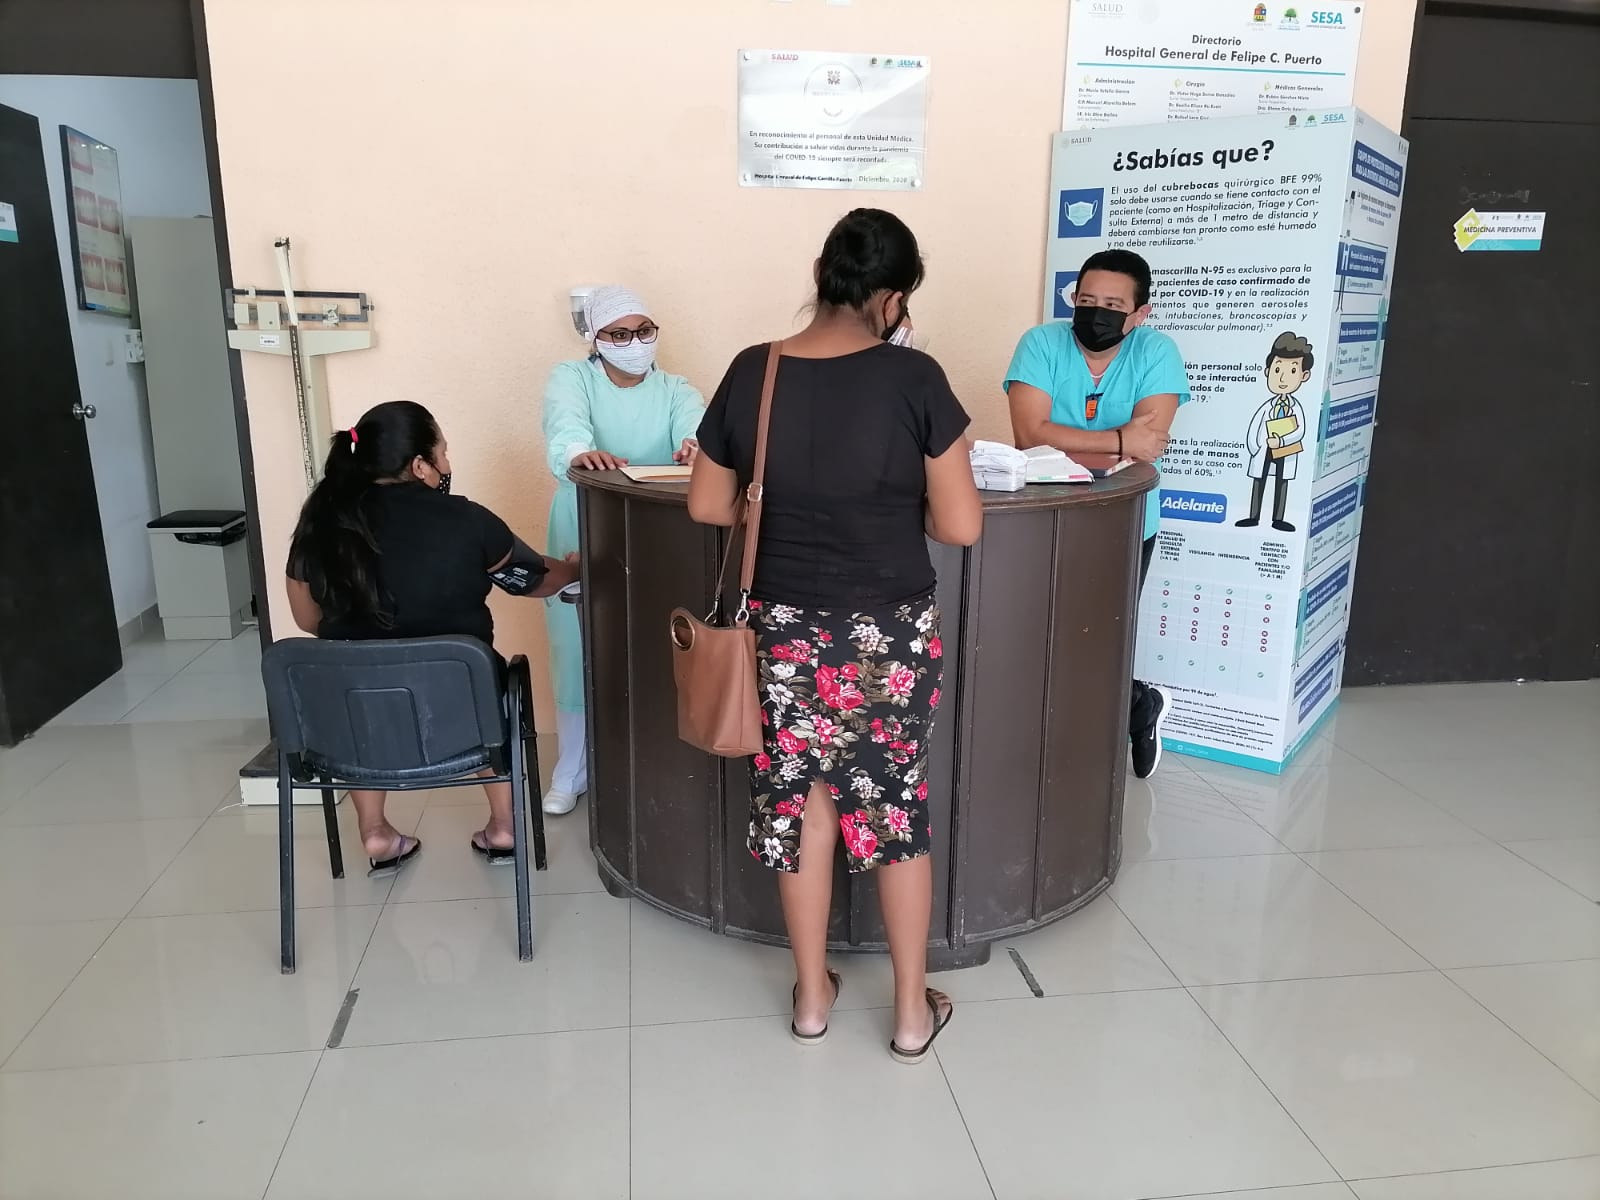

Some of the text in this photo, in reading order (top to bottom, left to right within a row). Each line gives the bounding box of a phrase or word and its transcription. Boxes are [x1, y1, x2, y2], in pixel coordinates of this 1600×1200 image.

[1092, 3, 1123, 12] SALUD
[1311, 11, 1343, 25] SESA
[1191, 34, 1242, 46] Directorio
[1105, 45, 1322, 65] Hospital General de Felipe C. Puerto
[1324, 113, 1345, 122] SESA
[817, 154, 842, 163] siempre
[1112, 139, 1275, 172] ¿Sabías que?
[1111, 173, 1322, 195] El uso del cubrebocas quirúrgico BFE 99%
[1110, 185, 1321, 205] solo debe usarse cuando se tiene contacto con el
[1109, 207, 1144, 218] paciente
[1145, 205, 1171, 216] (como
[1186, 201, 1254, 213] Hospitalización,
[1257, 200, 1286, 210] Triage
[1287, 200, 1294, 209] y
[1295, 197, 1319, 207] Con-
[1108, 217, 1128, 227] sulta
[1131, 216, 1164, 226] Externa)
[1176, 215, 1194, 223] más
[1197, 214, 1209, 223] de
[1213, 213, 1218, 222] 1
[1222, 213, 1248, 222] metro
[1252, 211, 1264, 220] de
[1267, 209, 1309, 219] distancia
[1312, 211, 1319, 219] y
[1138, 226, 1180, 236] cambiarse
[1183, 226, 1197, 234] tan
[1198, 225, 1228, 236] pronto
[1257, 222, 1275, 231] esté
[1107, 241, 1112, 249] y
[1126, 238, 1147, 247] debe
[1151, 266, 1199, 275] mascarilla
[1201, 265, 1225, 275] N-95
[1238, 264, 1278, 274] exclusivo
[1279, 266, 1301, 275] para
[1303, 263, 1312, 273] la
[1157, 275, 1311, 288] pacientes de caso confirmado de
[1160, 291, 1176, 299] por
[1178, 288, 1225, 297] COVID-19
[1227, 290, 1232, 298] y
[1249, 287, 1258, 296] la
[1260, 287, 1310, 297] realización
[1192, 302, 1210, 310] que
[1215, 302, 1255, 310] generen
[1261, 299, 1309, 308] aerosoles
[1165, 311, 1307, 322] intubaciones, y
[1154, 321, 1215, 331] cardiovascular
[1217, 322, 1266, 333] pulmonar).
[1201, 362, 1242, 371] personal
[1244, 363, 1263, 371] solo
[1209, 373, 1257, 382] interactúa
[1190, 383, 1225, 392] ados de
[1190, 437, 1198, 446] la
[1200, 438, 1245, 449] realización
[1192, 447, 1204, 456] de
[1207, 450, 1240, 459] manos
[1184, 467, 1192, 475] al
[1161, 496, 1225, 514] Adelante
